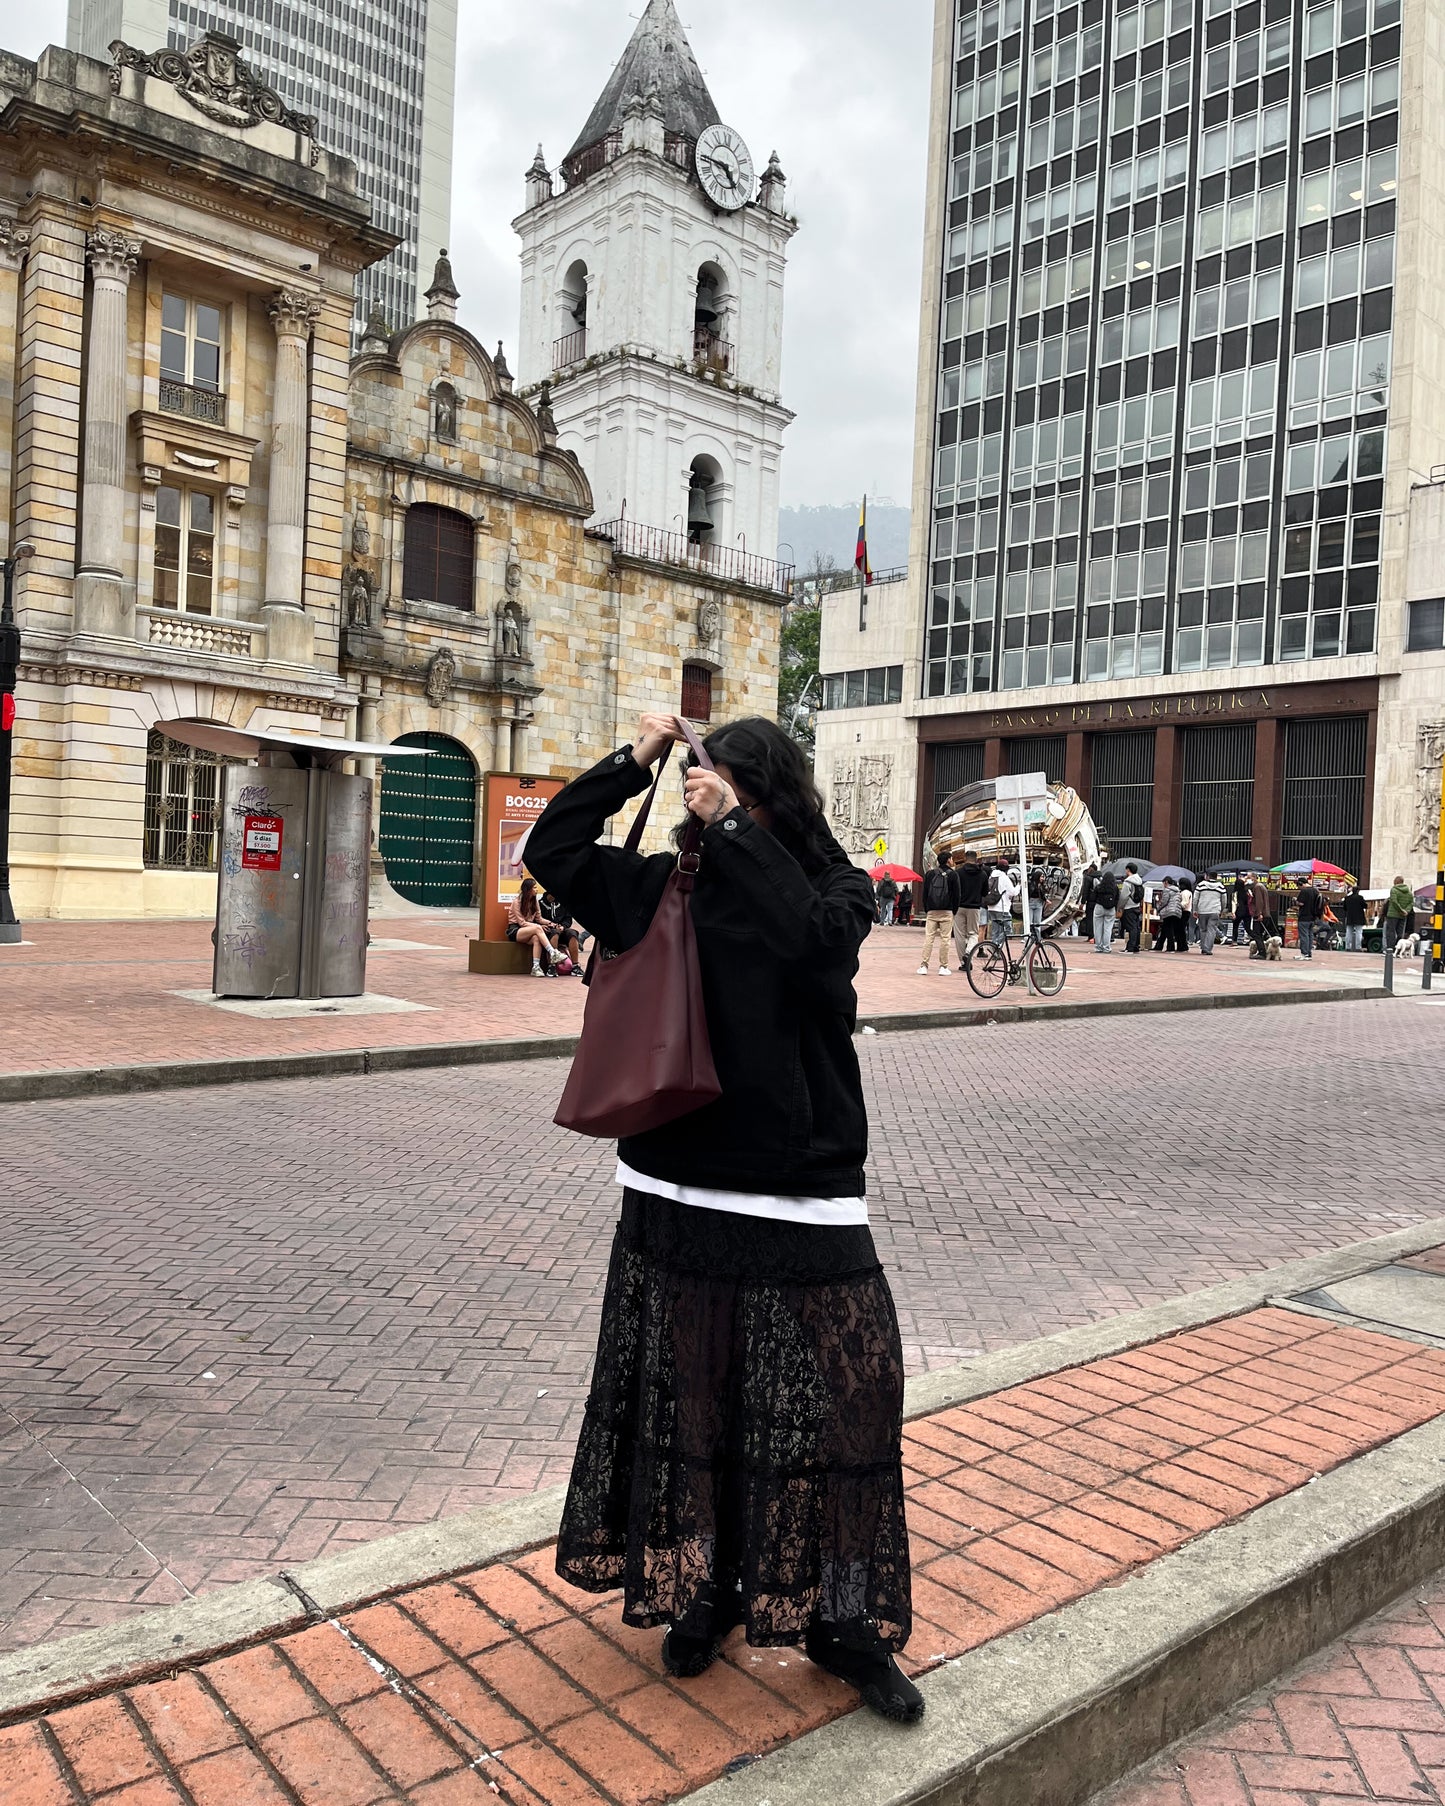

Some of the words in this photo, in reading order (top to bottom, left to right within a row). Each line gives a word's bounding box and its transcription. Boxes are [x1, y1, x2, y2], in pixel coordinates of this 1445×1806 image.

[991, 711, 1060, 728] BANCO
[1072, 706, 1095, 721] DE
[1108, 704, 1134, 719] LA
[506, 795, 548, 809] BOG25
[251, 820, 275, 829] Claro
